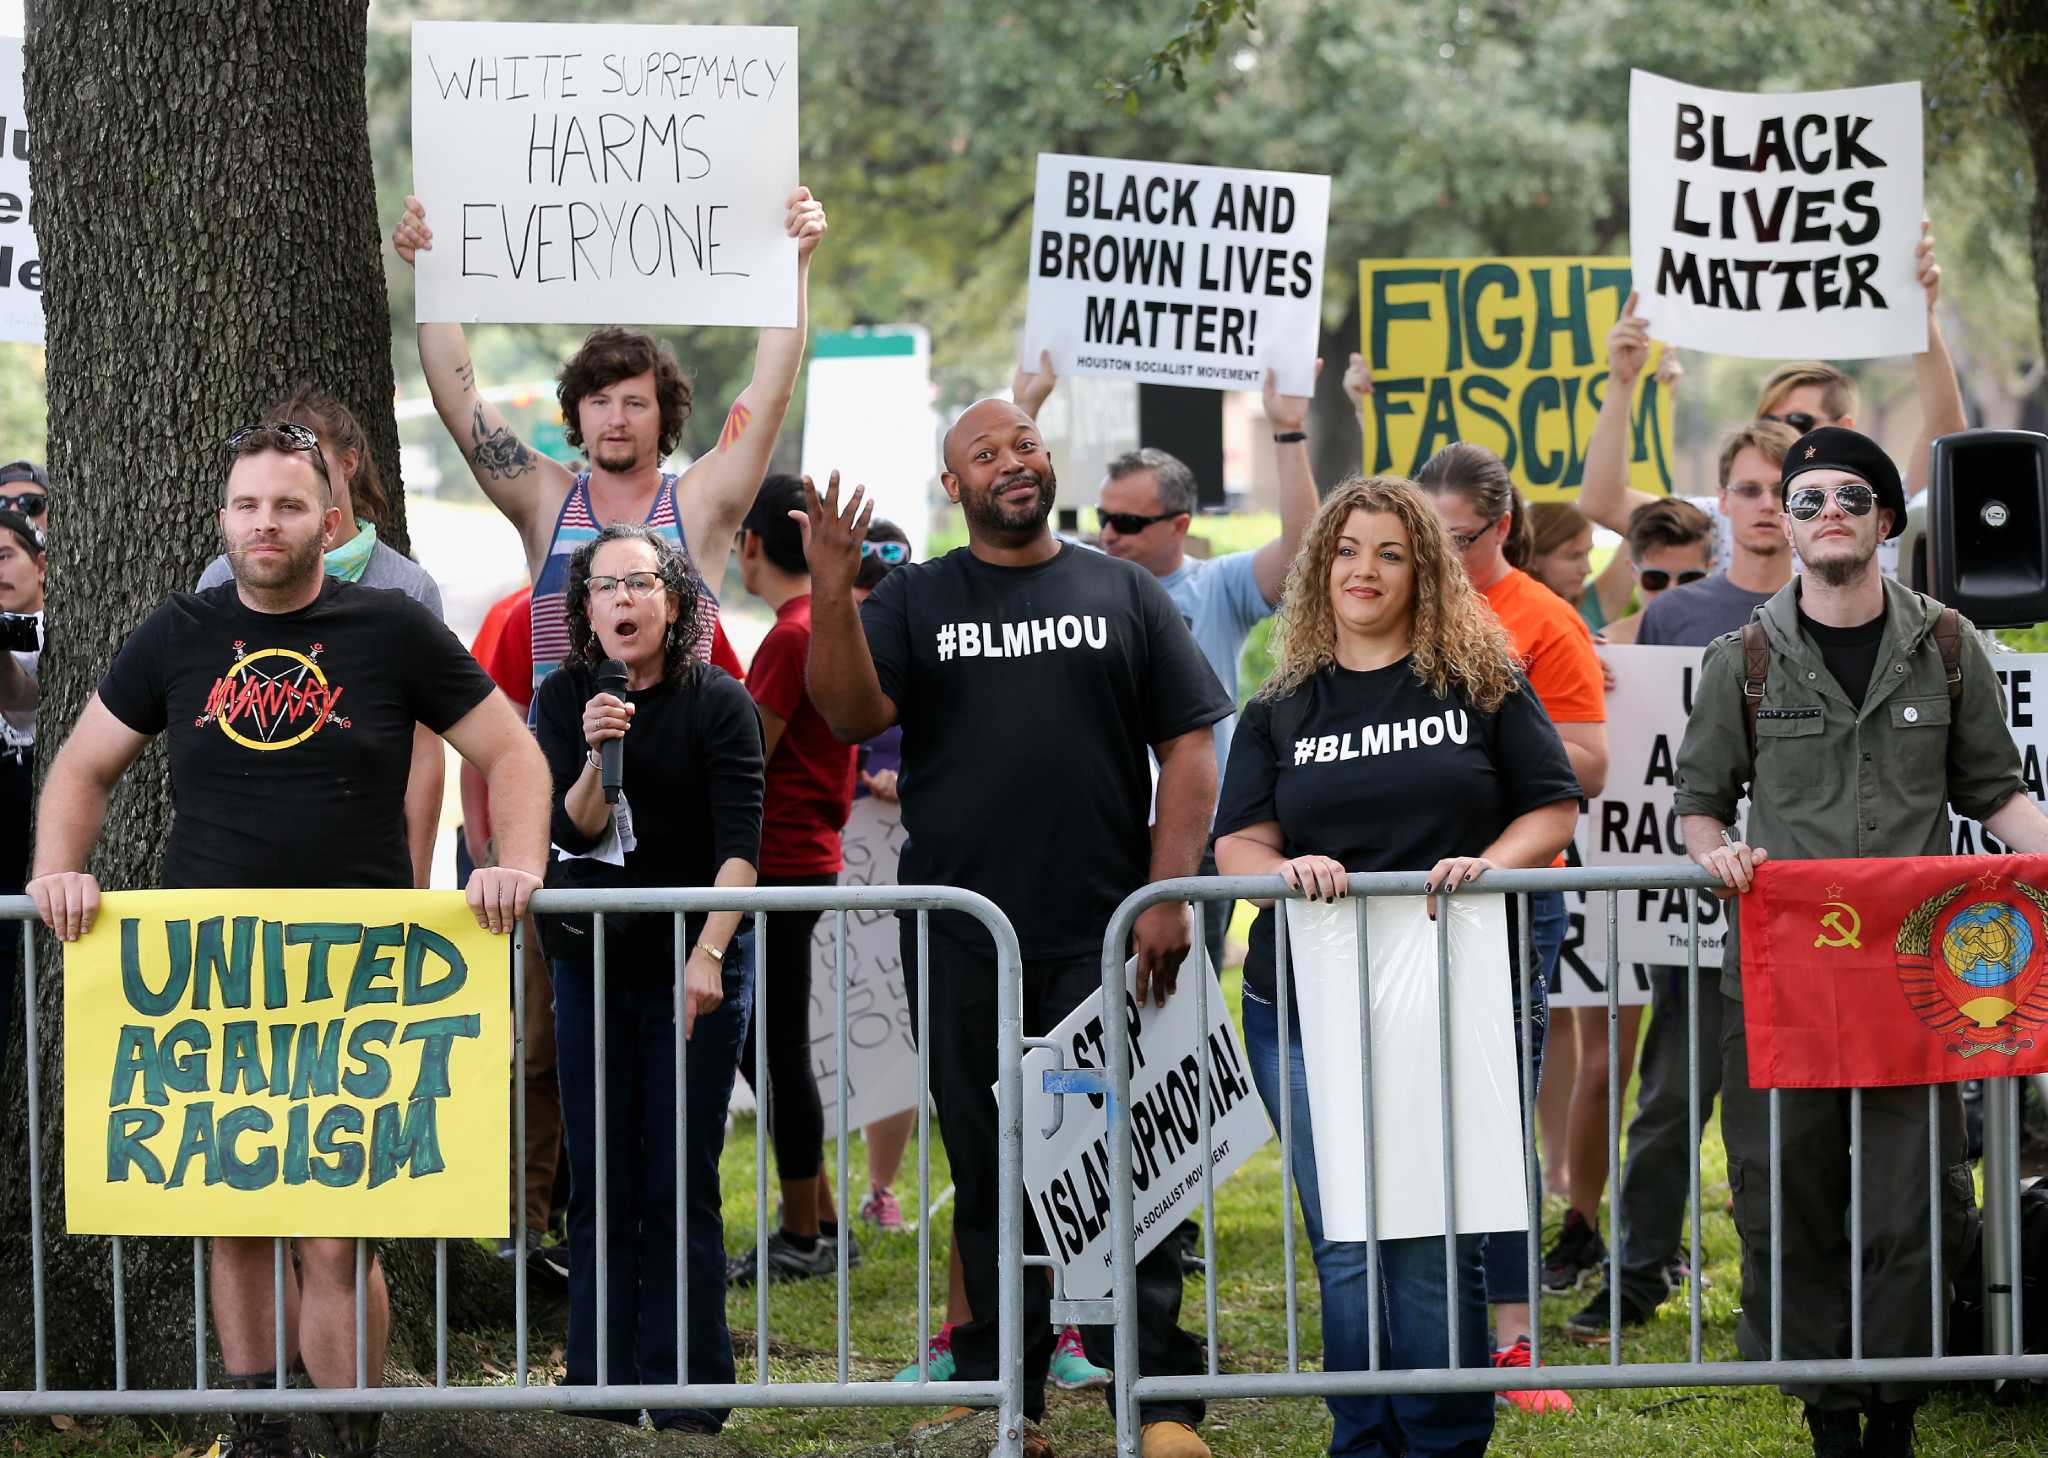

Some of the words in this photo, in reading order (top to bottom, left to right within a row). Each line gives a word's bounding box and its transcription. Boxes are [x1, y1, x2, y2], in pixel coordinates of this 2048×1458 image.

[428, 53, 581, 100] WHITE
[602, 52, 785, 102] SUPREMACY
[529, 113, 710, 186] HARMS
[1674, 102, 1888, 175] BLACK
[1066, 170, 1200, 227] BLACK
[1211, 183, 1295, 233] AND
[1674, 179, 1881, 246] LIVES
[462, 200, 749, 282] EVERYONE
[1039, 230, 1184, 288] BROWN
[1198, 243, 1312, 298] LIVES
[1656, 247, 1889, 312] MATTER
[1084, 296, 1258, 356] MATTER!
[1077, 357, 1132, 371] HOUSTON
[1135, 361, 1193, 375] SOCIALIST
[1197, 367, 1259, 382] MOVEMENT
[936, 614, 1107, 661] #BLMHOU
[1294, 709, 1468, 766] #BLMHOU
[120, 916, 467, 1016] UNITED
[109, 1013, 480, 1107] AGAINST
[1072, 990, 1146, 1109] STP
[106, 1098, 446, 1190] RACISM
[1143, 1183, 1185, 1229] SOCIALIST
[1185, 1140, 1230, 1190] MOVENT
